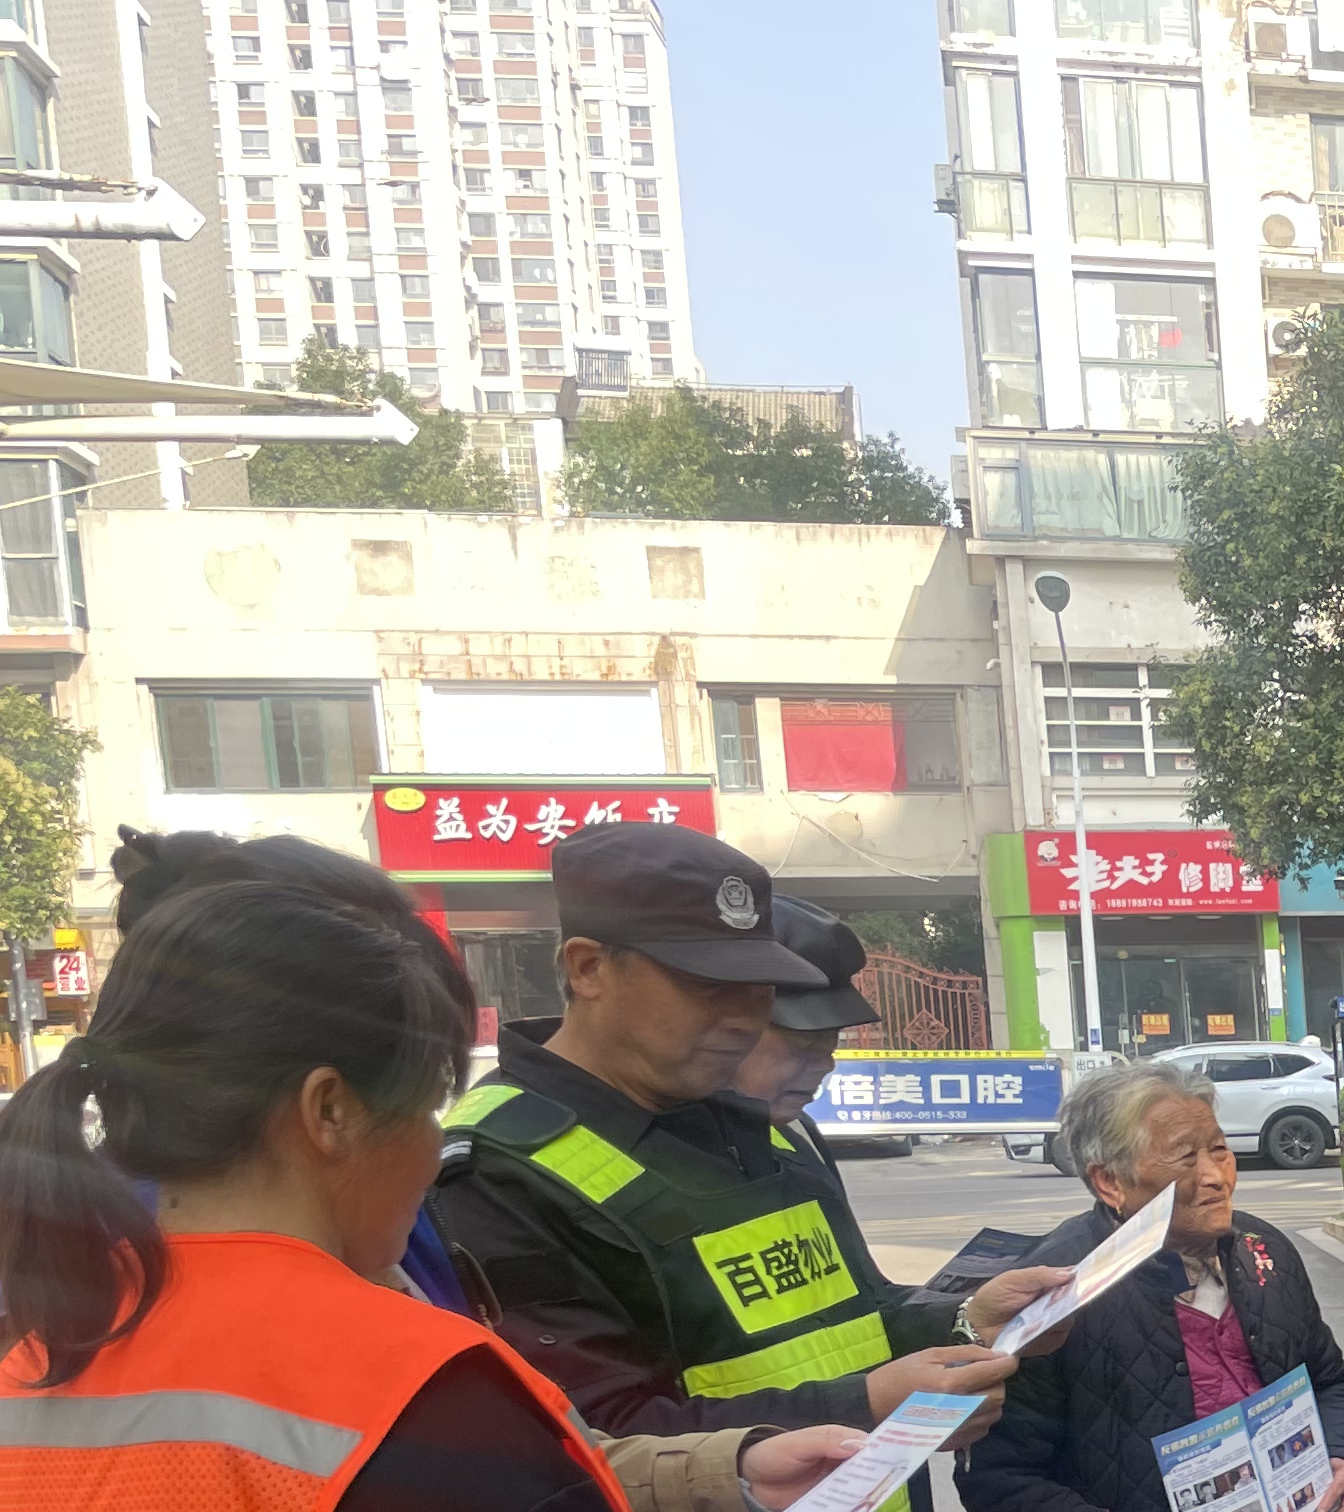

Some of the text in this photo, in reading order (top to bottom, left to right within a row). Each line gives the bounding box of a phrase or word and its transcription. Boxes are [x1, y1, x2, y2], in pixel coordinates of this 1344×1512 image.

[58, 954, 82, 976] 24
[1076, 1058, 1096, 1071] 出口
[827, 1073, 1024, 1105] 倍美口腔
